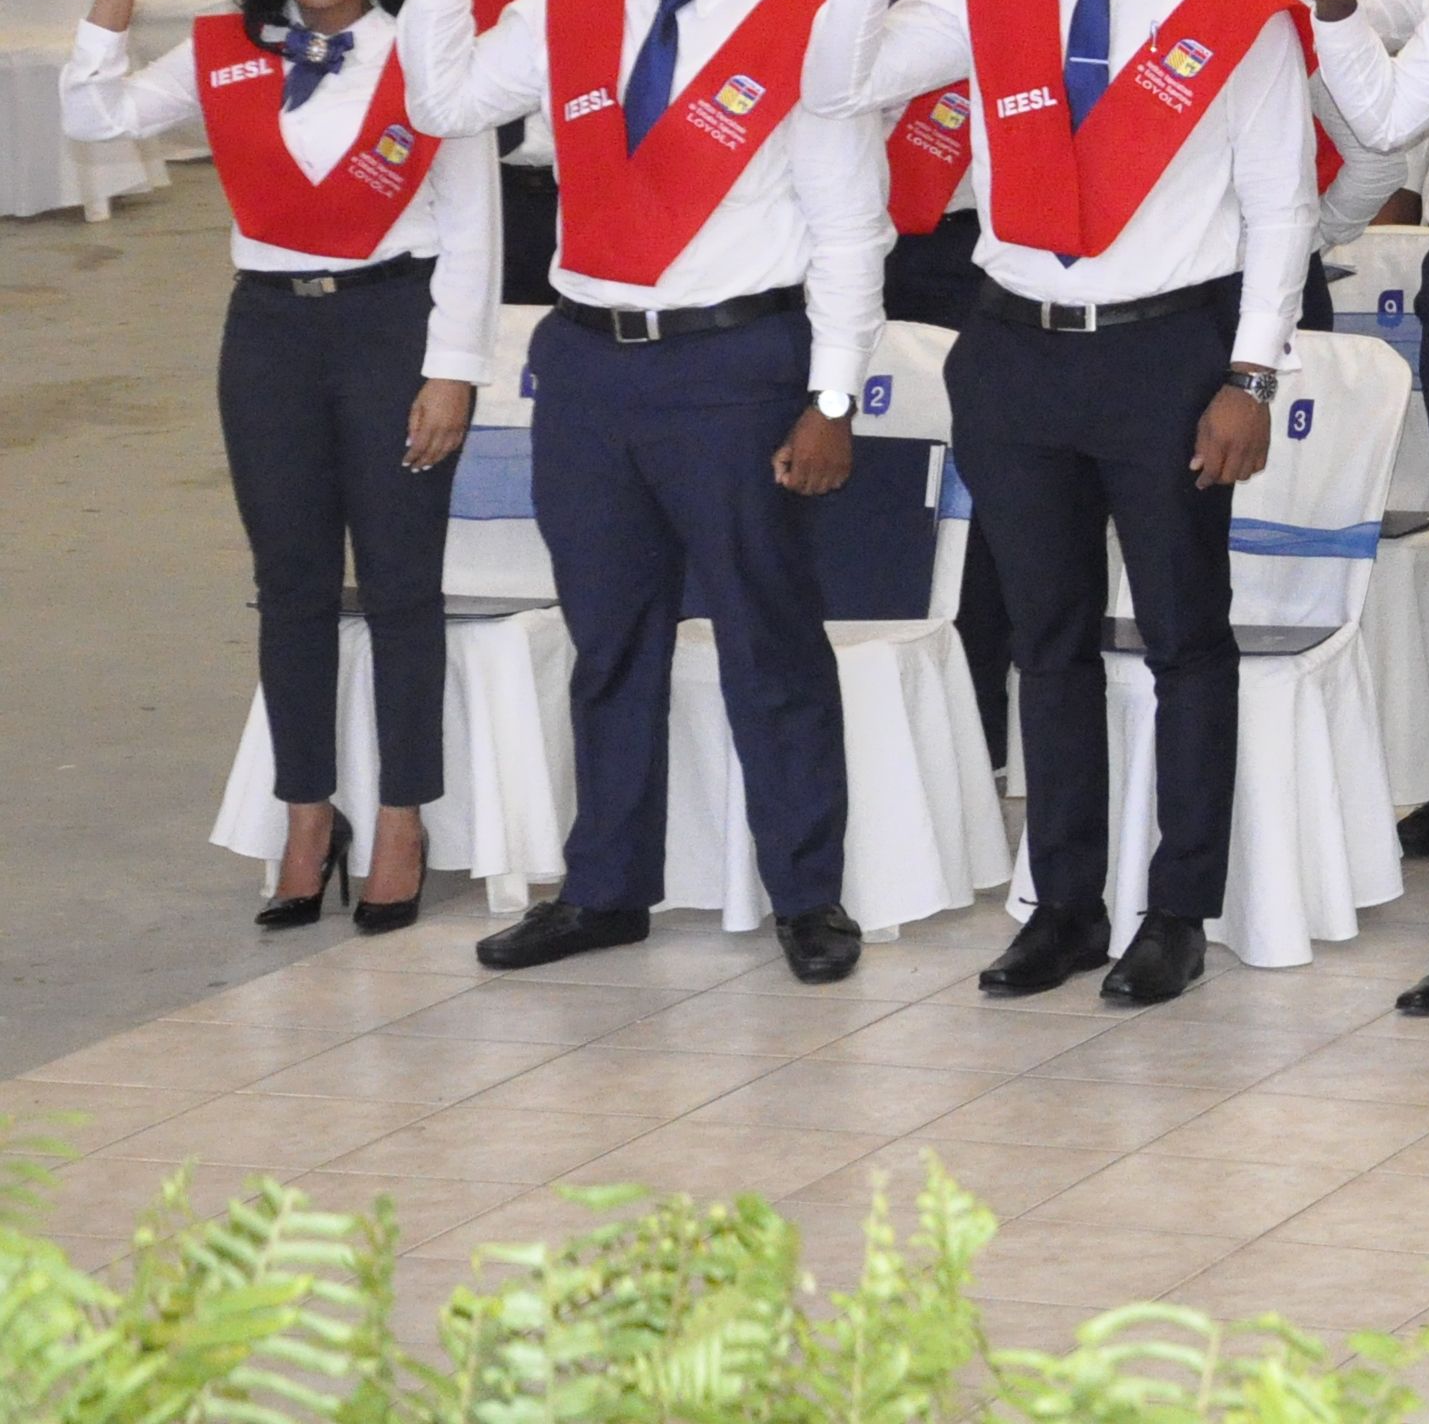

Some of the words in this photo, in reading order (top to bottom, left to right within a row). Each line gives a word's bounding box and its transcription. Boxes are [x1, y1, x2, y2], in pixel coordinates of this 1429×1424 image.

[210, 58, 274, 89] IEESL
[564, 87, 615, 122] IEESL
[997, 86, 1057, 118] IEESL
[1135, 74, 1183, 114] LOYOLA
[686, 113, 736, 150] LOYOLA
[906, 133, 953, 164] LOYOLA
[870, 387, 884, 407] 2
[1294, 410, 1306, 431] 3
